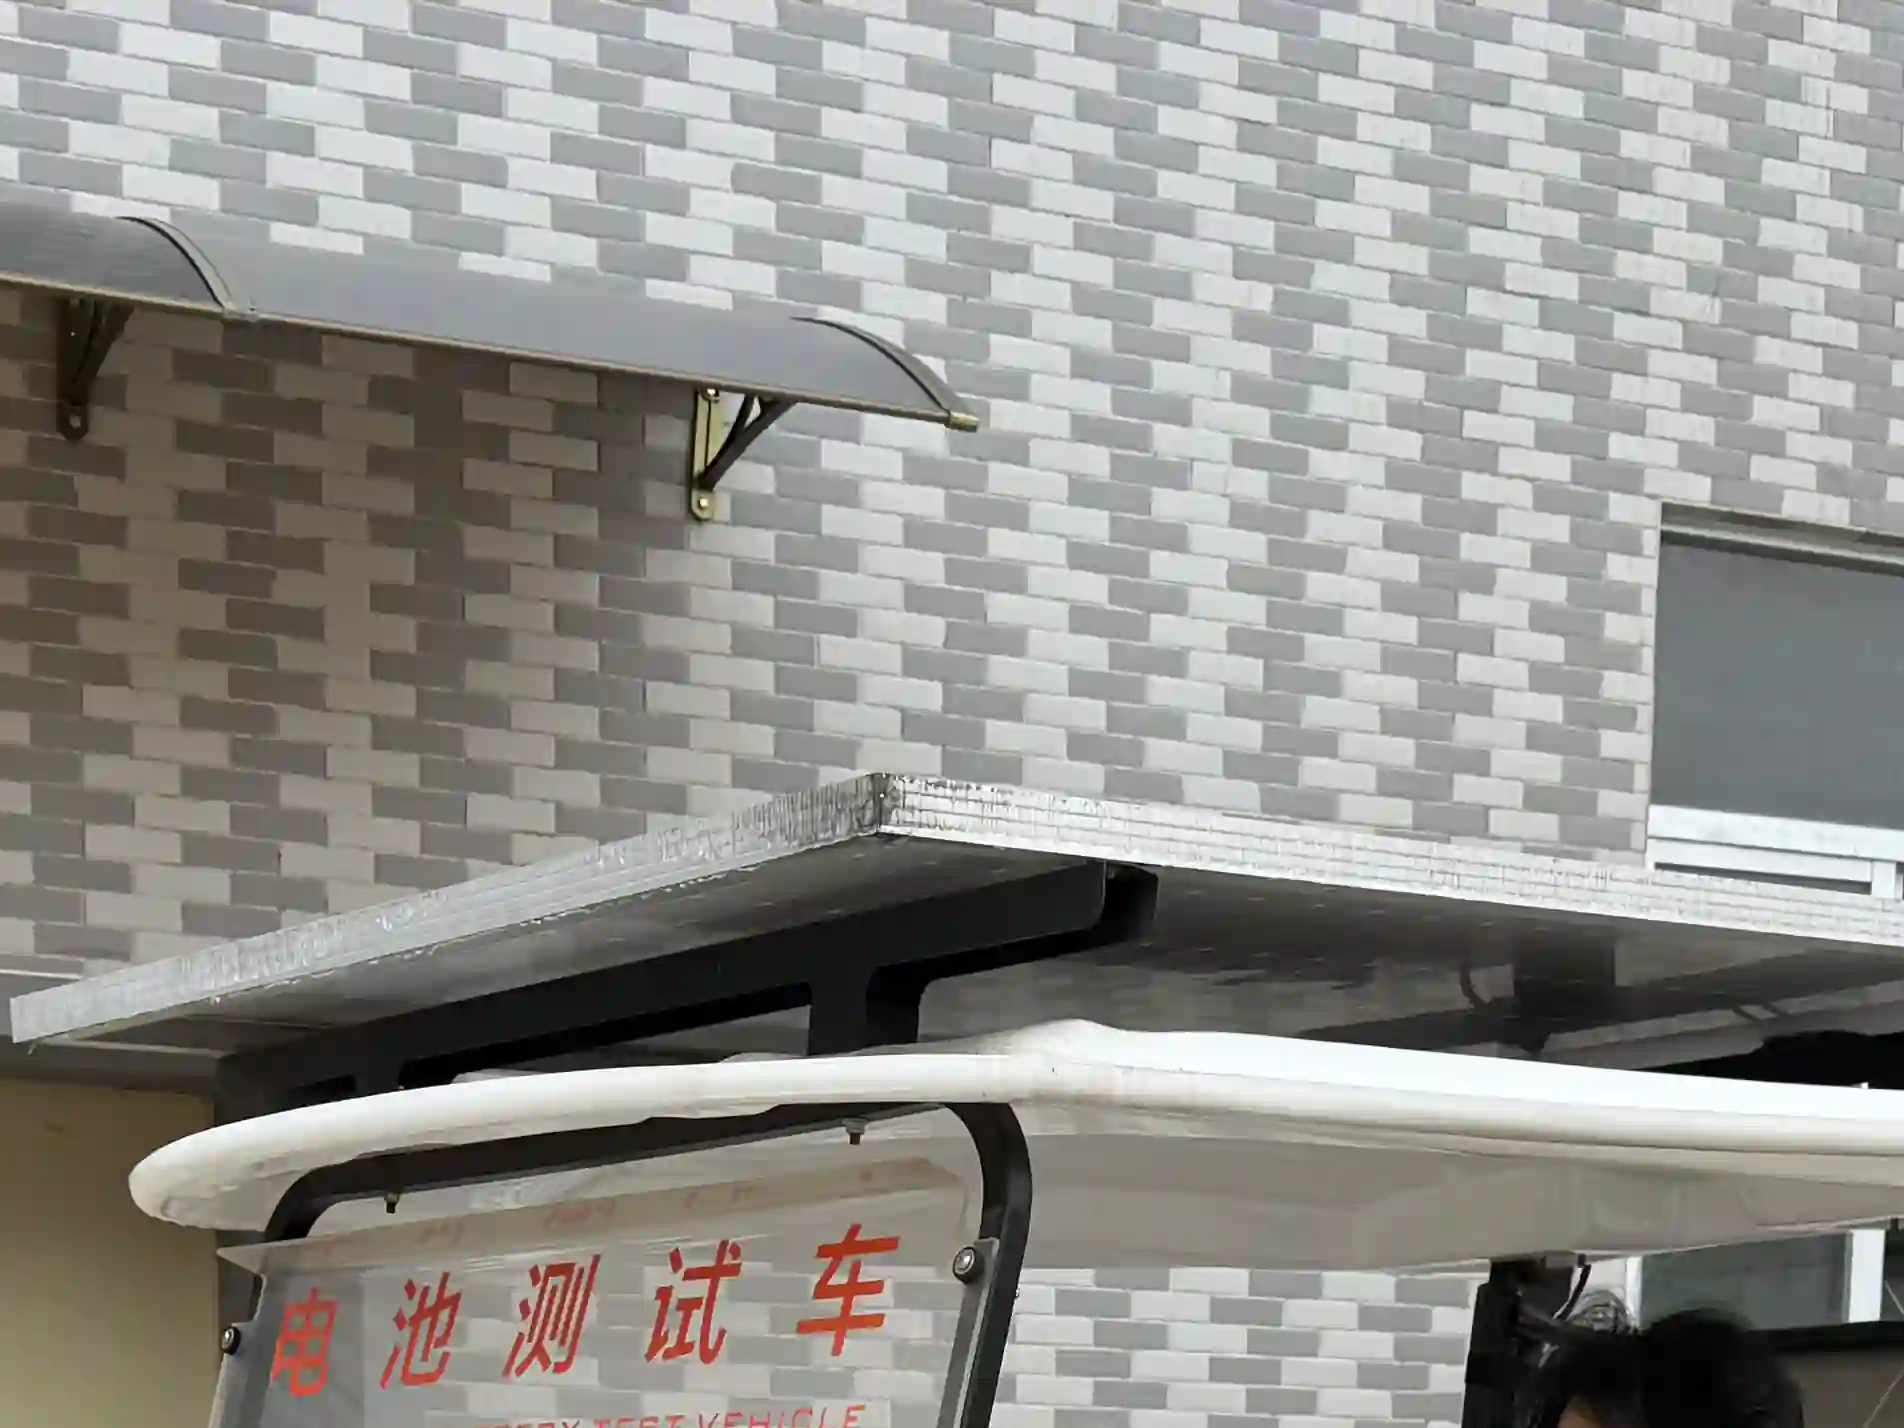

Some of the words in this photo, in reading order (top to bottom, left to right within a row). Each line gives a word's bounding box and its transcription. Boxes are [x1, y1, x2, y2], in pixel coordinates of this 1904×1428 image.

[270, 1223, 900, 1398] 电池测试车
